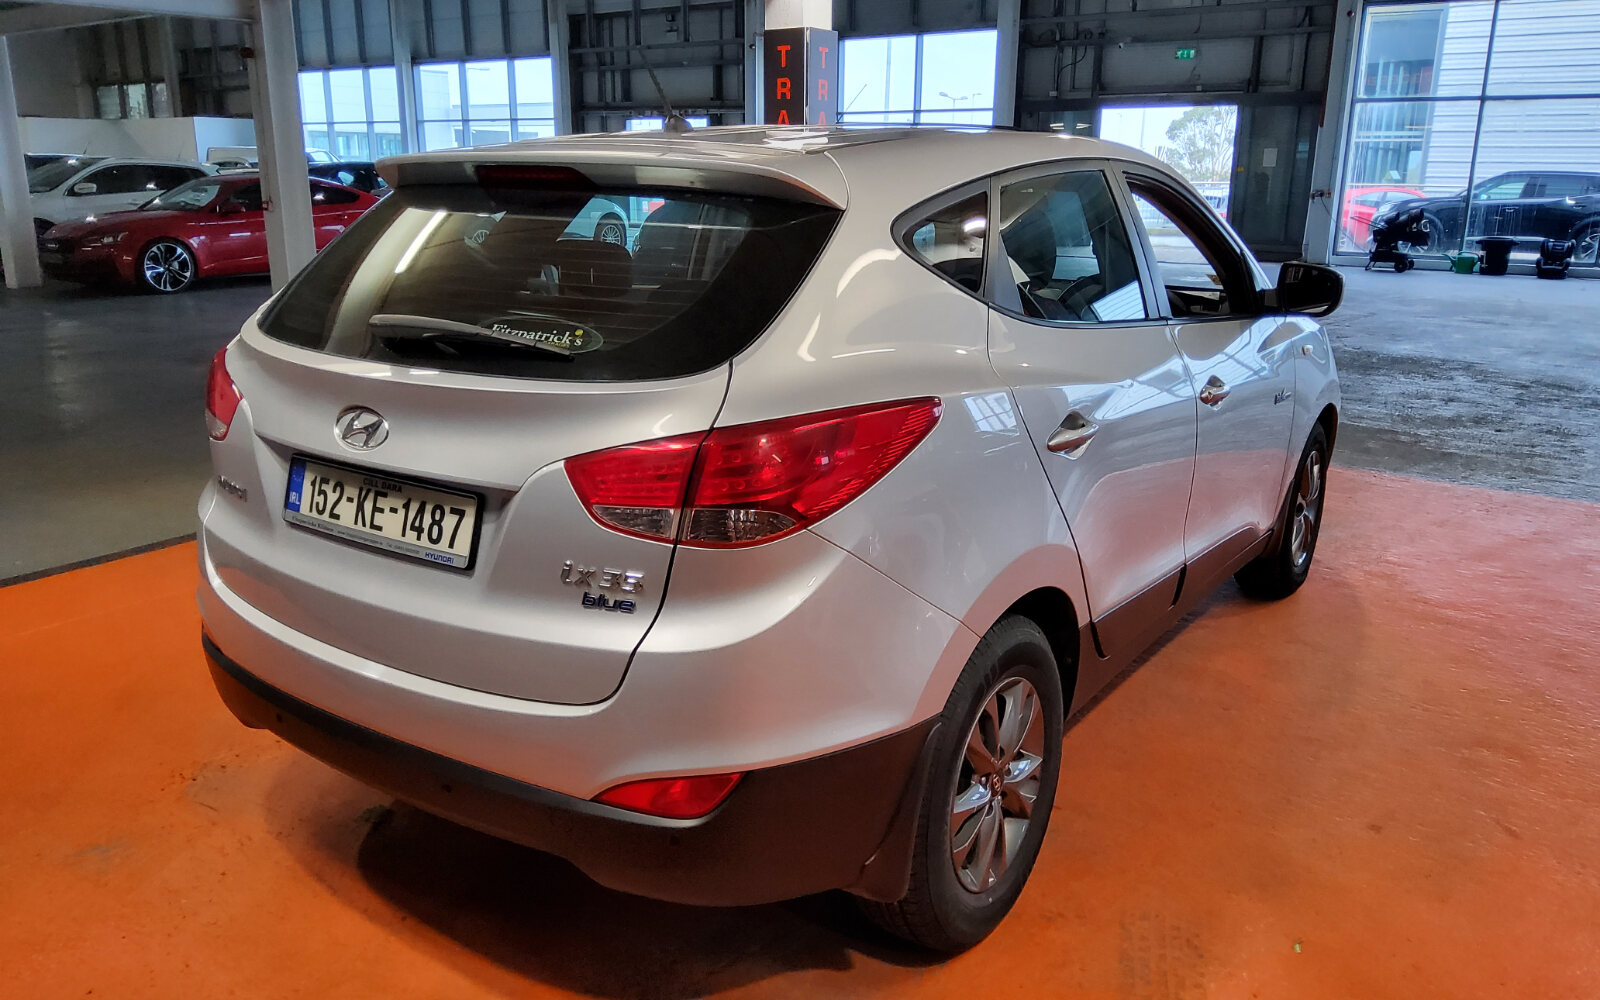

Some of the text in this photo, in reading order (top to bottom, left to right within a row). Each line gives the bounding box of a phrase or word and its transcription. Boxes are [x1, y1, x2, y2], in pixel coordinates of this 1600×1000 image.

[362, 477, 402, 493] CILL DARA
[289, 491, 300, 505] IRL
[308, 475, 466, 549] 152-KE-1487
[424, 551, 454, 564] HYUNDAI
[582, 591, 637, 614] blue
